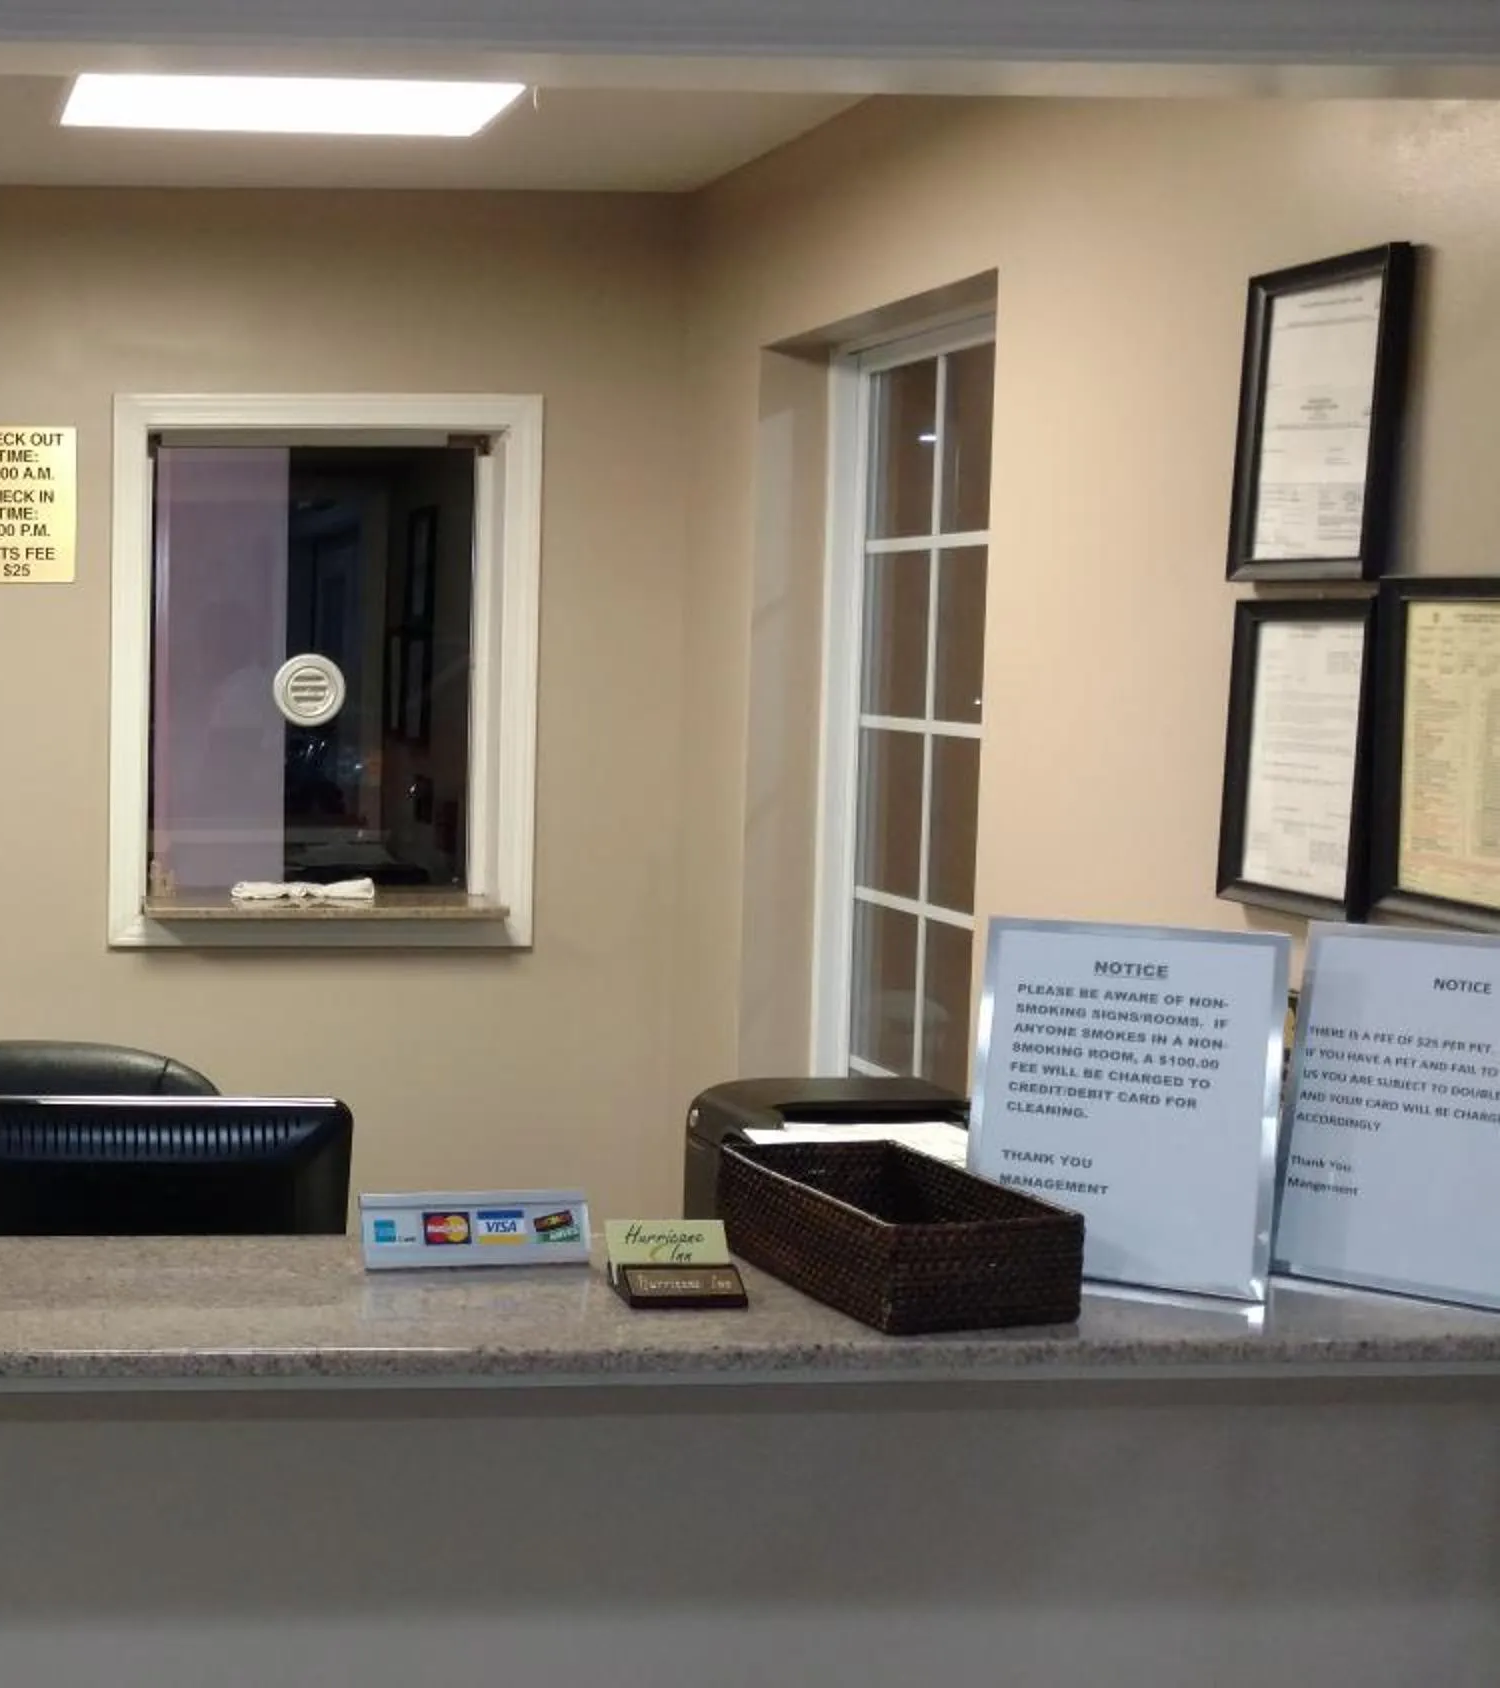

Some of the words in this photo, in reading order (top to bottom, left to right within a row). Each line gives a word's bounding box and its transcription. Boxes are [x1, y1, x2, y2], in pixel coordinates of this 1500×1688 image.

[30, 432, 64, 446] OUT
[23, 467, 55, 480] A.M.
[39, 489, 55, 503] IN
[20, 523, 50, 537] P.M.
[25, 547, 56, 560] FEE
[3, 563, 31, 577] $25
[1093, 961, 1170, 979] NOTICE
[1017, 983, 1074, 997] PLEASE
[1079, 987, 1099, 999] BE
[1103, 989, 1159, 1005] AWARE
[1163, 994, 1185, 1006] OF
[1189, 997, 1229, 1009] NON-
[1433, 978, 1492, 995] NOTICE
[1016, 1003, 1087, 1019] SMOKING
[1214, 1018, 1228, 1029] IF
[1014, 1022, 1077, 1037] ANYONE
[1081, 1028, 1146, 1043] SMOKES
[1151, 1033, 1167, 1045] IN
[1172, 1035, 1183, 1046] A
[1310, 1025, 1345, 1039] THERE
[1349, 1029, 1360, 1040] IS
[1361, 1031, 1371, 1041] A
[1373, 1032, 1395, 1044] FEE
[1397, 1034, 1414, 1046] OF
[1416, 1036, 1438, 1049] $25
[1441, 1040, 1466, 1051] PER
[1011, 1042, 1083, 1058] SMOKING
[1143, 1053, 1153, 1064] A
[1159, 1055, 1220, 1070] $100.00
[1305, 1048, 1316, 1058] IF
[1319, 1050, 1344, 1061] YOU
[1347, 1053, 1380, 1065] HAVE
[1383, 1057, 1392, 1067] A
[1395, 1057, 1416, 1069] PET
[1420, 1061, 1448, 1072] AND
[1451, 1064, 1476, 1075] FAIL
[1481, 1067, 1498, 1078] TO
[1010, 1061, 1037, 1074] FEE
[1041, 1064, 1077, 1077] WILL
[1083, 1068, 1102, 1080] BE
[1108, 1070, 1184, 1087] CHARGED
[1188, 1077, 1212, 1089] TO
[1303, 1069, 1318, 1080] US
[1322, 1070, 1346, 1082] YOU
[1350, 1073, 1373, 1085] ARE
[1376, 1077, 1426, 1093] SUBJECT
[1432, 1084, 1448, 1095] TO
[1007, 1100, 1089, 1119] CLEANING.
[1117, 1091, 1161, 1106] CARD
[1165, 1096, 1197, 1109] FOR
[1300, 1090, 1326, 1103] AND
[1329, 1094, 1363, 1106] YOUR
[1366, 1098, 1399, 1111] CARD
[1402, 1103, 1431, 1115] WILL
[1435, 1107, 1450, 1118] BE
[1297, 1111, 1381, 1132] ACCORDINGLY
[1001, 1149, 1055, 1165] THANK
[1060, 1155, 1093, 1169] YOU
[1291, 1154, 1325, 1170] Thank
[1329, 1162, 1352, 1173] You
[999, 1173, 1109, 1195] MANAGEMENT
[485, 1220, 517, 1233] VISA
[625, 1223, 705, 1246] Hurricane
[670, 1243, 693, 1262] Inn
